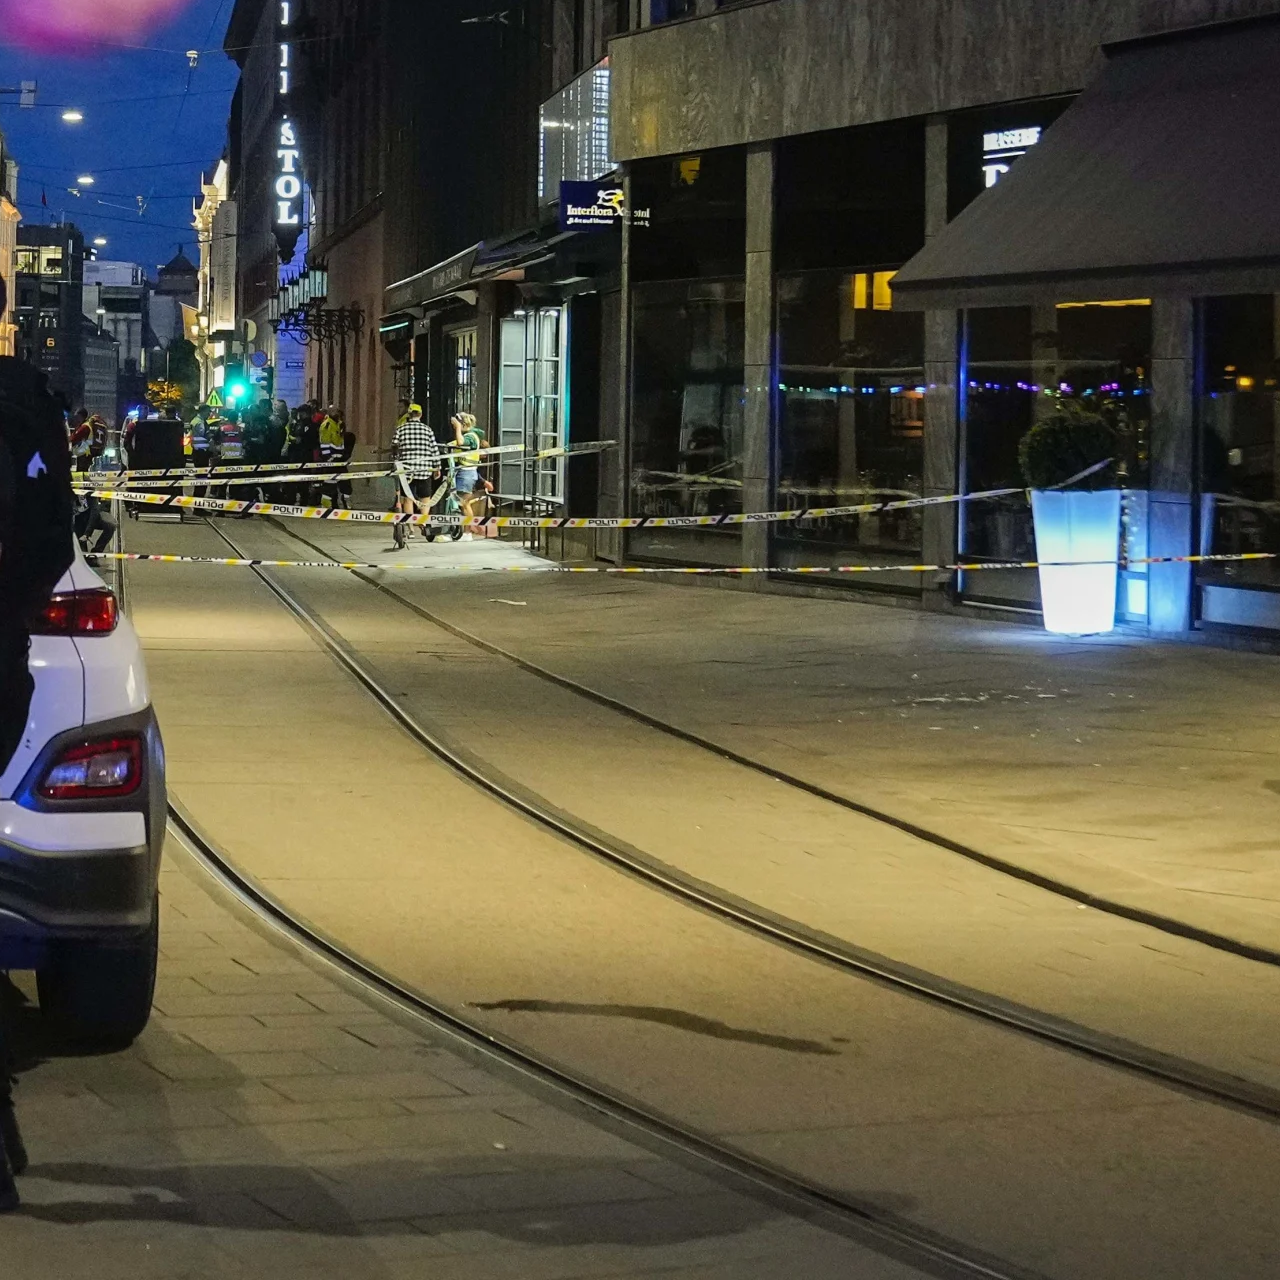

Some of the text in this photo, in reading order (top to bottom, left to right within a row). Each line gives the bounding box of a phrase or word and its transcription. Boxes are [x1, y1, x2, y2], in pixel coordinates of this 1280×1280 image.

[566, 204, 614, 216] Interflora
[46, 337, 55, 347] 6
[194, 500, 224, 509] POLITI
[273, 506, 303, 514] POLITI
[351, 513, 381, 521] POLITI
